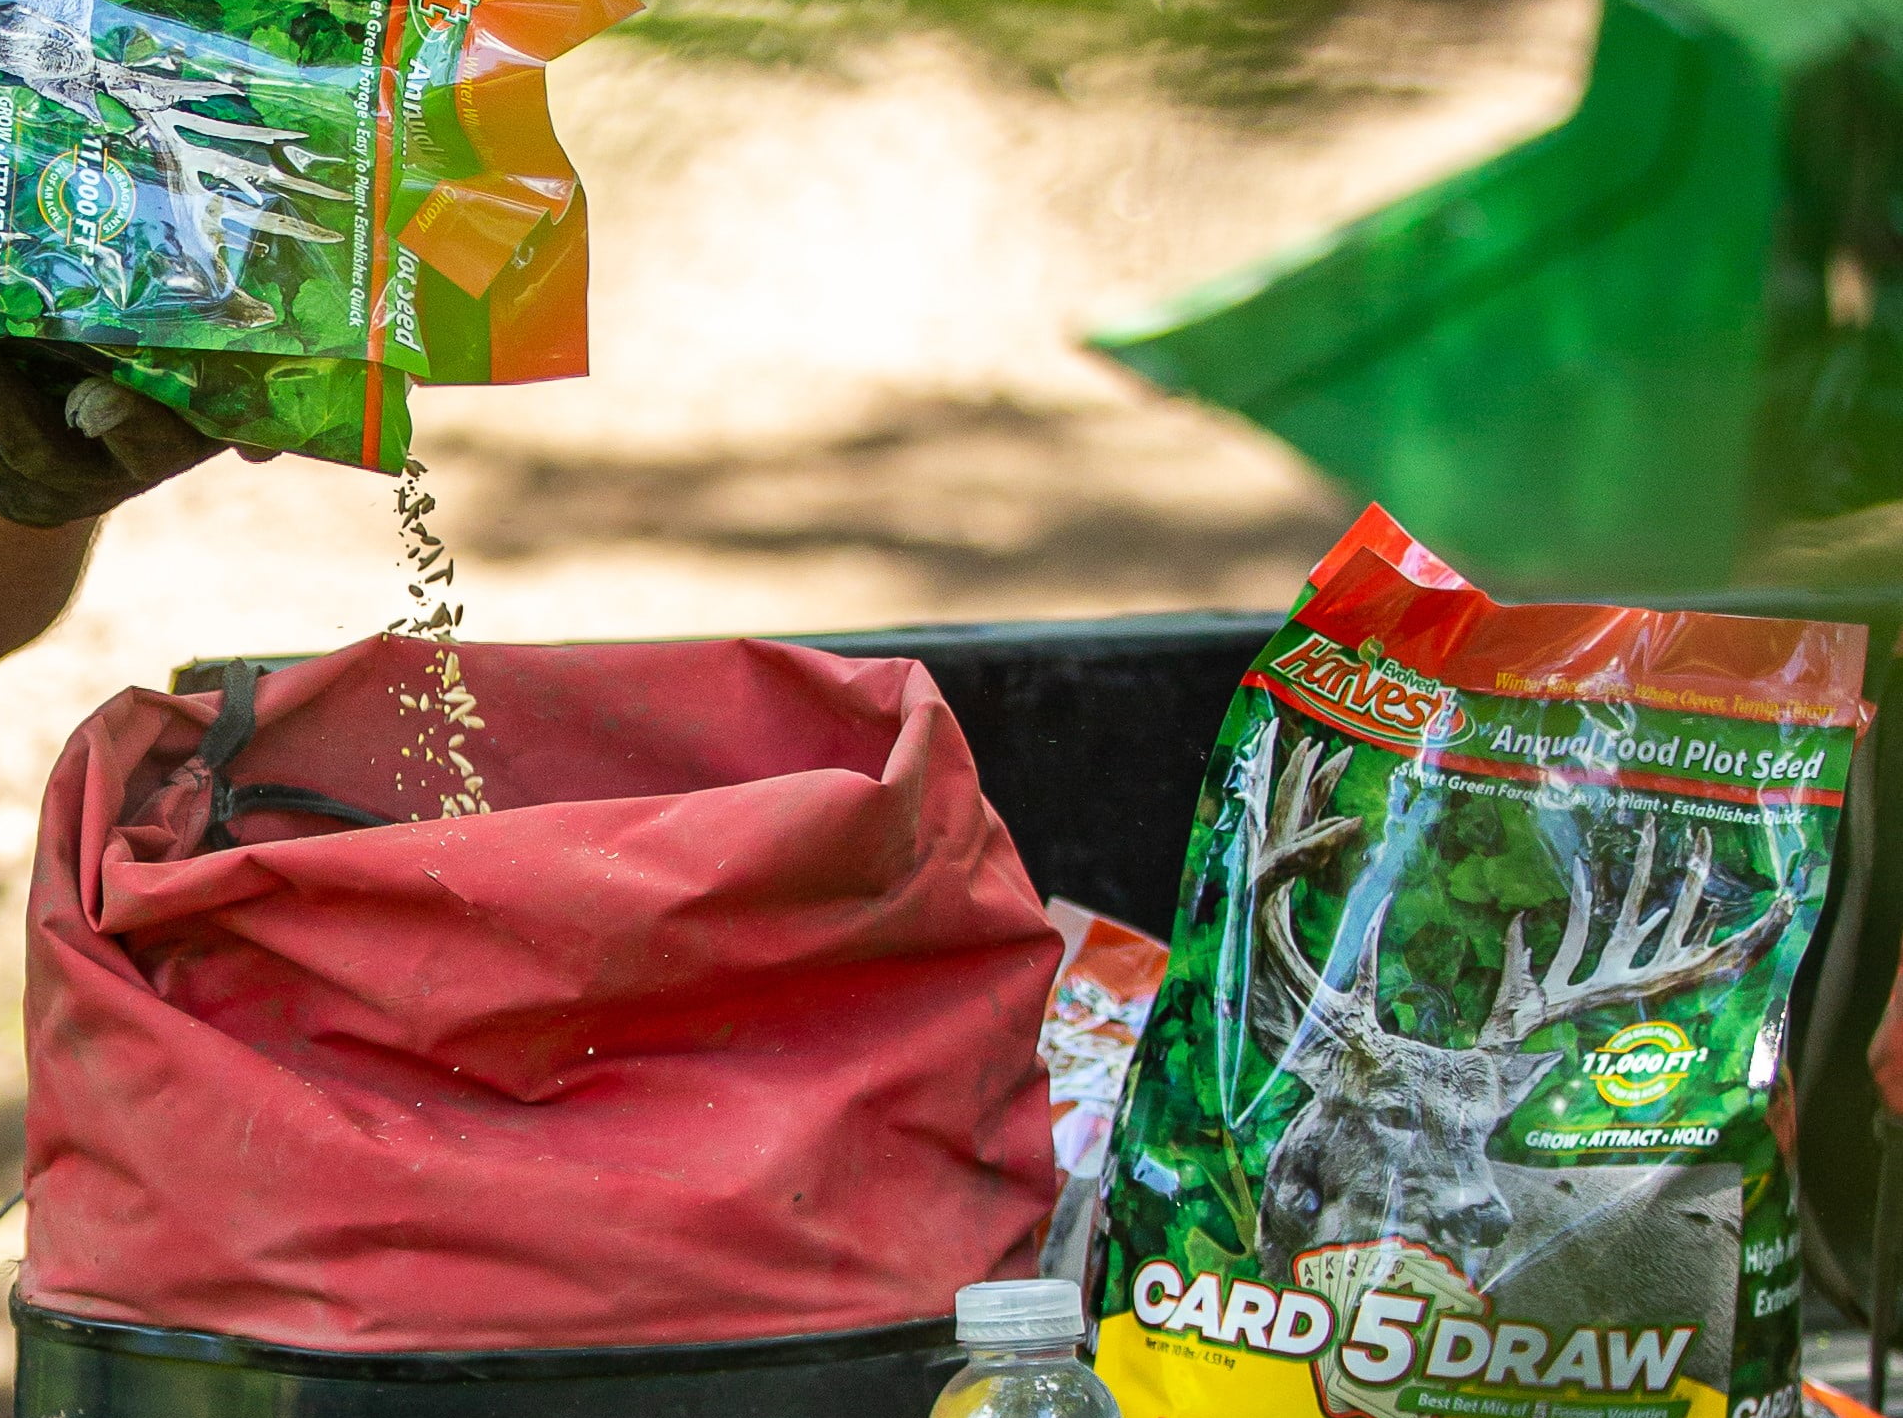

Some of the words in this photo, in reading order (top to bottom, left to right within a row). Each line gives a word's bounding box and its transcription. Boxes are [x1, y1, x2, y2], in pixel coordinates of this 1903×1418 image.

[360, 19, 382, 67] Green
[353, 67, 375, 119] Forage
[351, 128, 371, 156] Easy
[47, 171, 60, 187] OF
[75, 136, 104, 217] 11,000
[106, 162, 123, 181] THIS
[355, 157, 371, 172] To
[44, 186, 55, 201] AN
[117, 178, 131, 199] BAG
[353, 173, 369, 208] Plant
[44, 199, 63, 224] ACRE
[102, 198, 130, 234] PLANTS
[415, 184, 458, 233] Chicory
[352, 214, 369, 285] Establishes
[396, 247, 421, 285] lot
[348, 287, 366, 327] Quick
[1270, 632, 1458, 740] Harvest
[1382, 658, 1438, 695] Evolved
[1490, 725, 1598, 766] Annual
[1682, 738, 1748, 777] Plot
[1751, 749, 1826, 780] Seed
[1447, 776, 1495, 796] Green
[1616, 792, 1661, 812] Plant
[1671, 799, 1760, 825] Establishes
[1582, 1052, 1665, 1077] 11,000
[1524, 1130, 1583, 1150] GROW
[1586, 1127, 1665, 1149] ATTRACT
[1669, 1127, 1721, 1147] HOLD
[1133, 1259, 1336, 1358] CARD
[1340, 1290, 1428, 1384] 5
[1424, 1316, 1698, 1392] DRAW
[1417, 1392, 1450, 1411] Best
[1452, 1395, 1478, 1413] Bet
[1481, 1399, 1508, 1416] Mix
[1511, 1403, 1528, 1418] of
